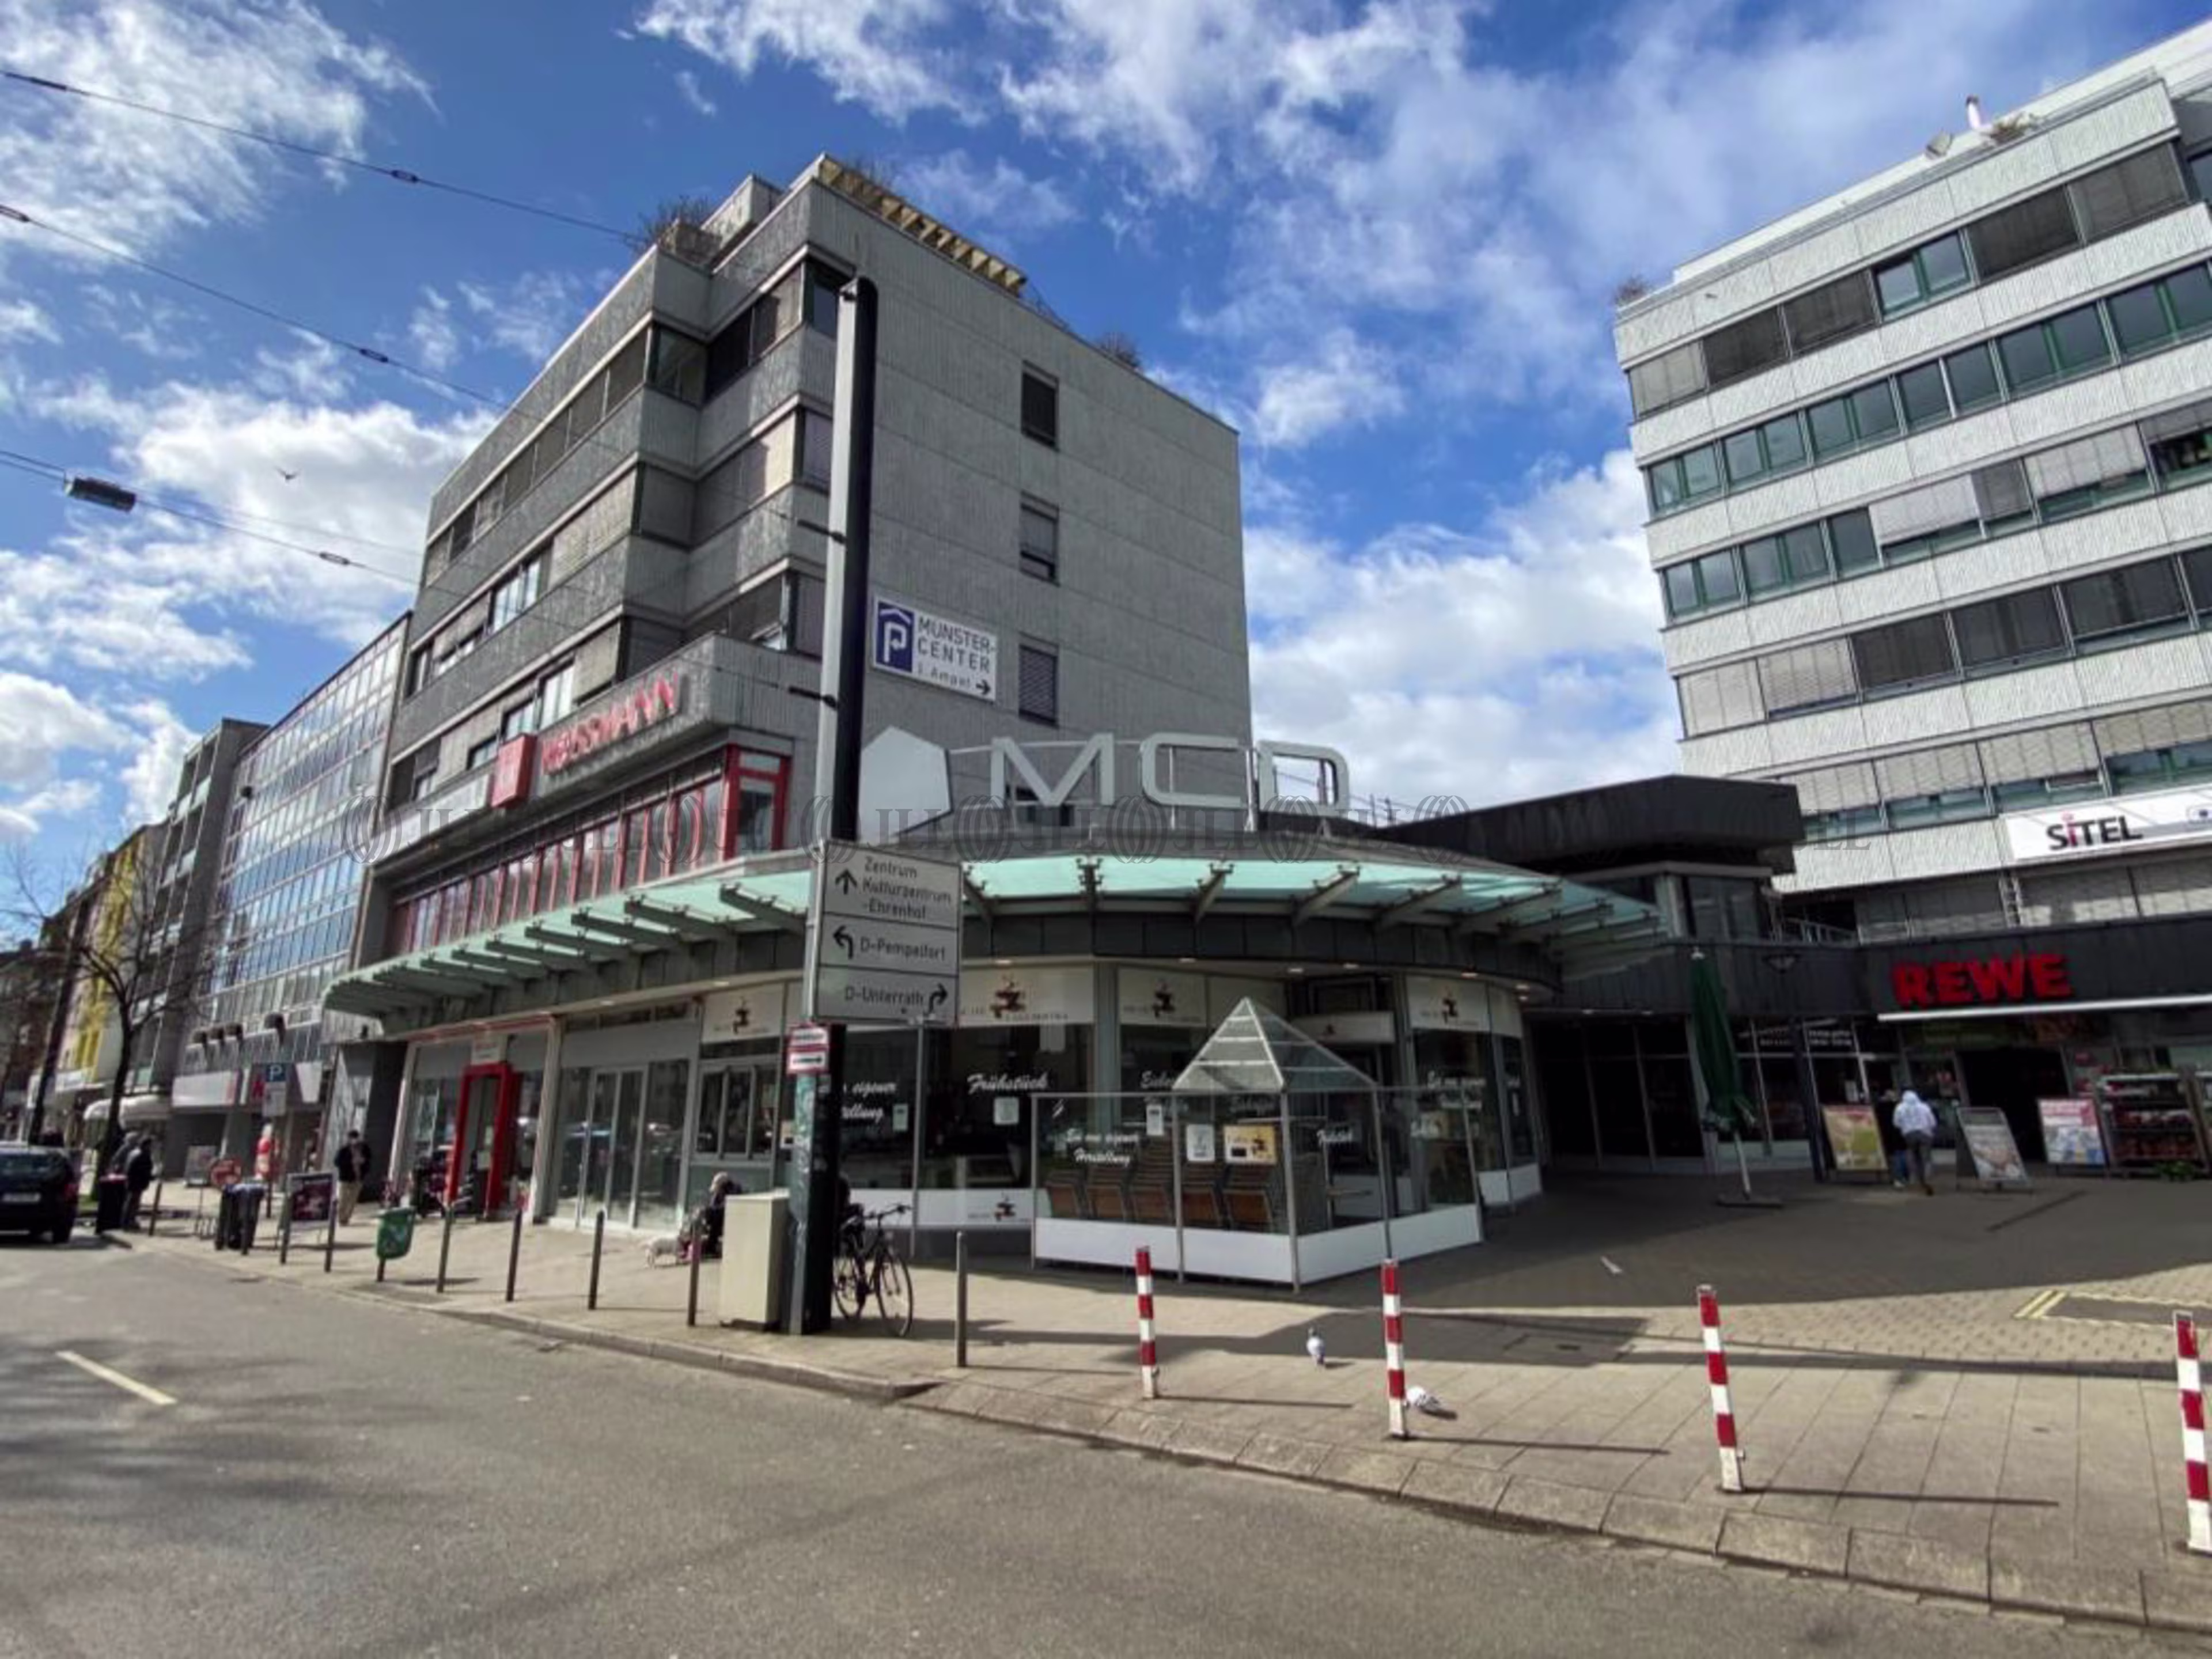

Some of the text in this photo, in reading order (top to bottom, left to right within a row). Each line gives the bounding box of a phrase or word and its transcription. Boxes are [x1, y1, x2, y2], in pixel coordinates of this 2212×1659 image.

[918, 636, 990, 674] CENTER
[864, 856, 918, 878] Zentrum
[1892, 953, 2075, 1008] REWE
